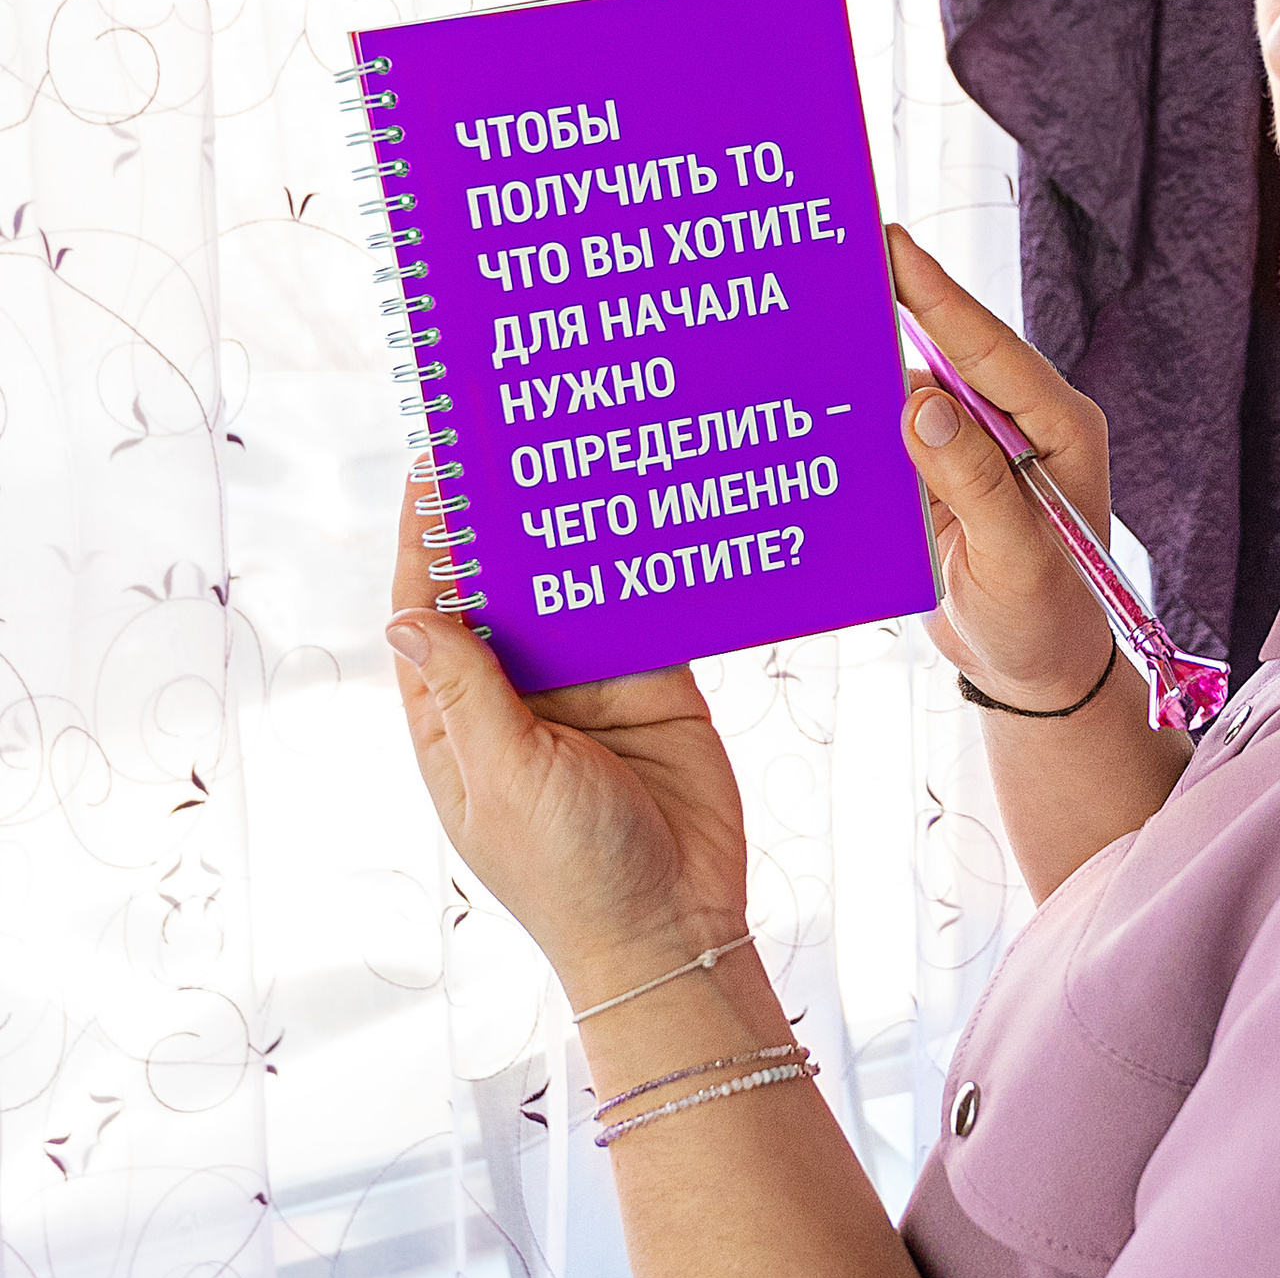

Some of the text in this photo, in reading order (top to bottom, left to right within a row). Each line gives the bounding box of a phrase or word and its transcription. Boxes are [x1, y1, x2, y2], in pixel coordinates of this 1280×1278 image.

[455, 99, 621, 161] ЧТОБЫ
[466, 141, 795, 230] ПОЛУЧИТЬ ТО,
[477, 197, 846, 292] ЧТО ВЫ ХОТИТЕ,
[491, 272, 790, 370] ДЛЯ НАЧАЛА
[499, 356, 676, 425] НУЖНО
[511, 398, 813, 488] ОПРЕДЕЛИТЬ
[521, 455, 839, 549] ЧЕГО ИМЕННО
[532, 525, 805, 616] ВЫ ХОТИТЕ?
